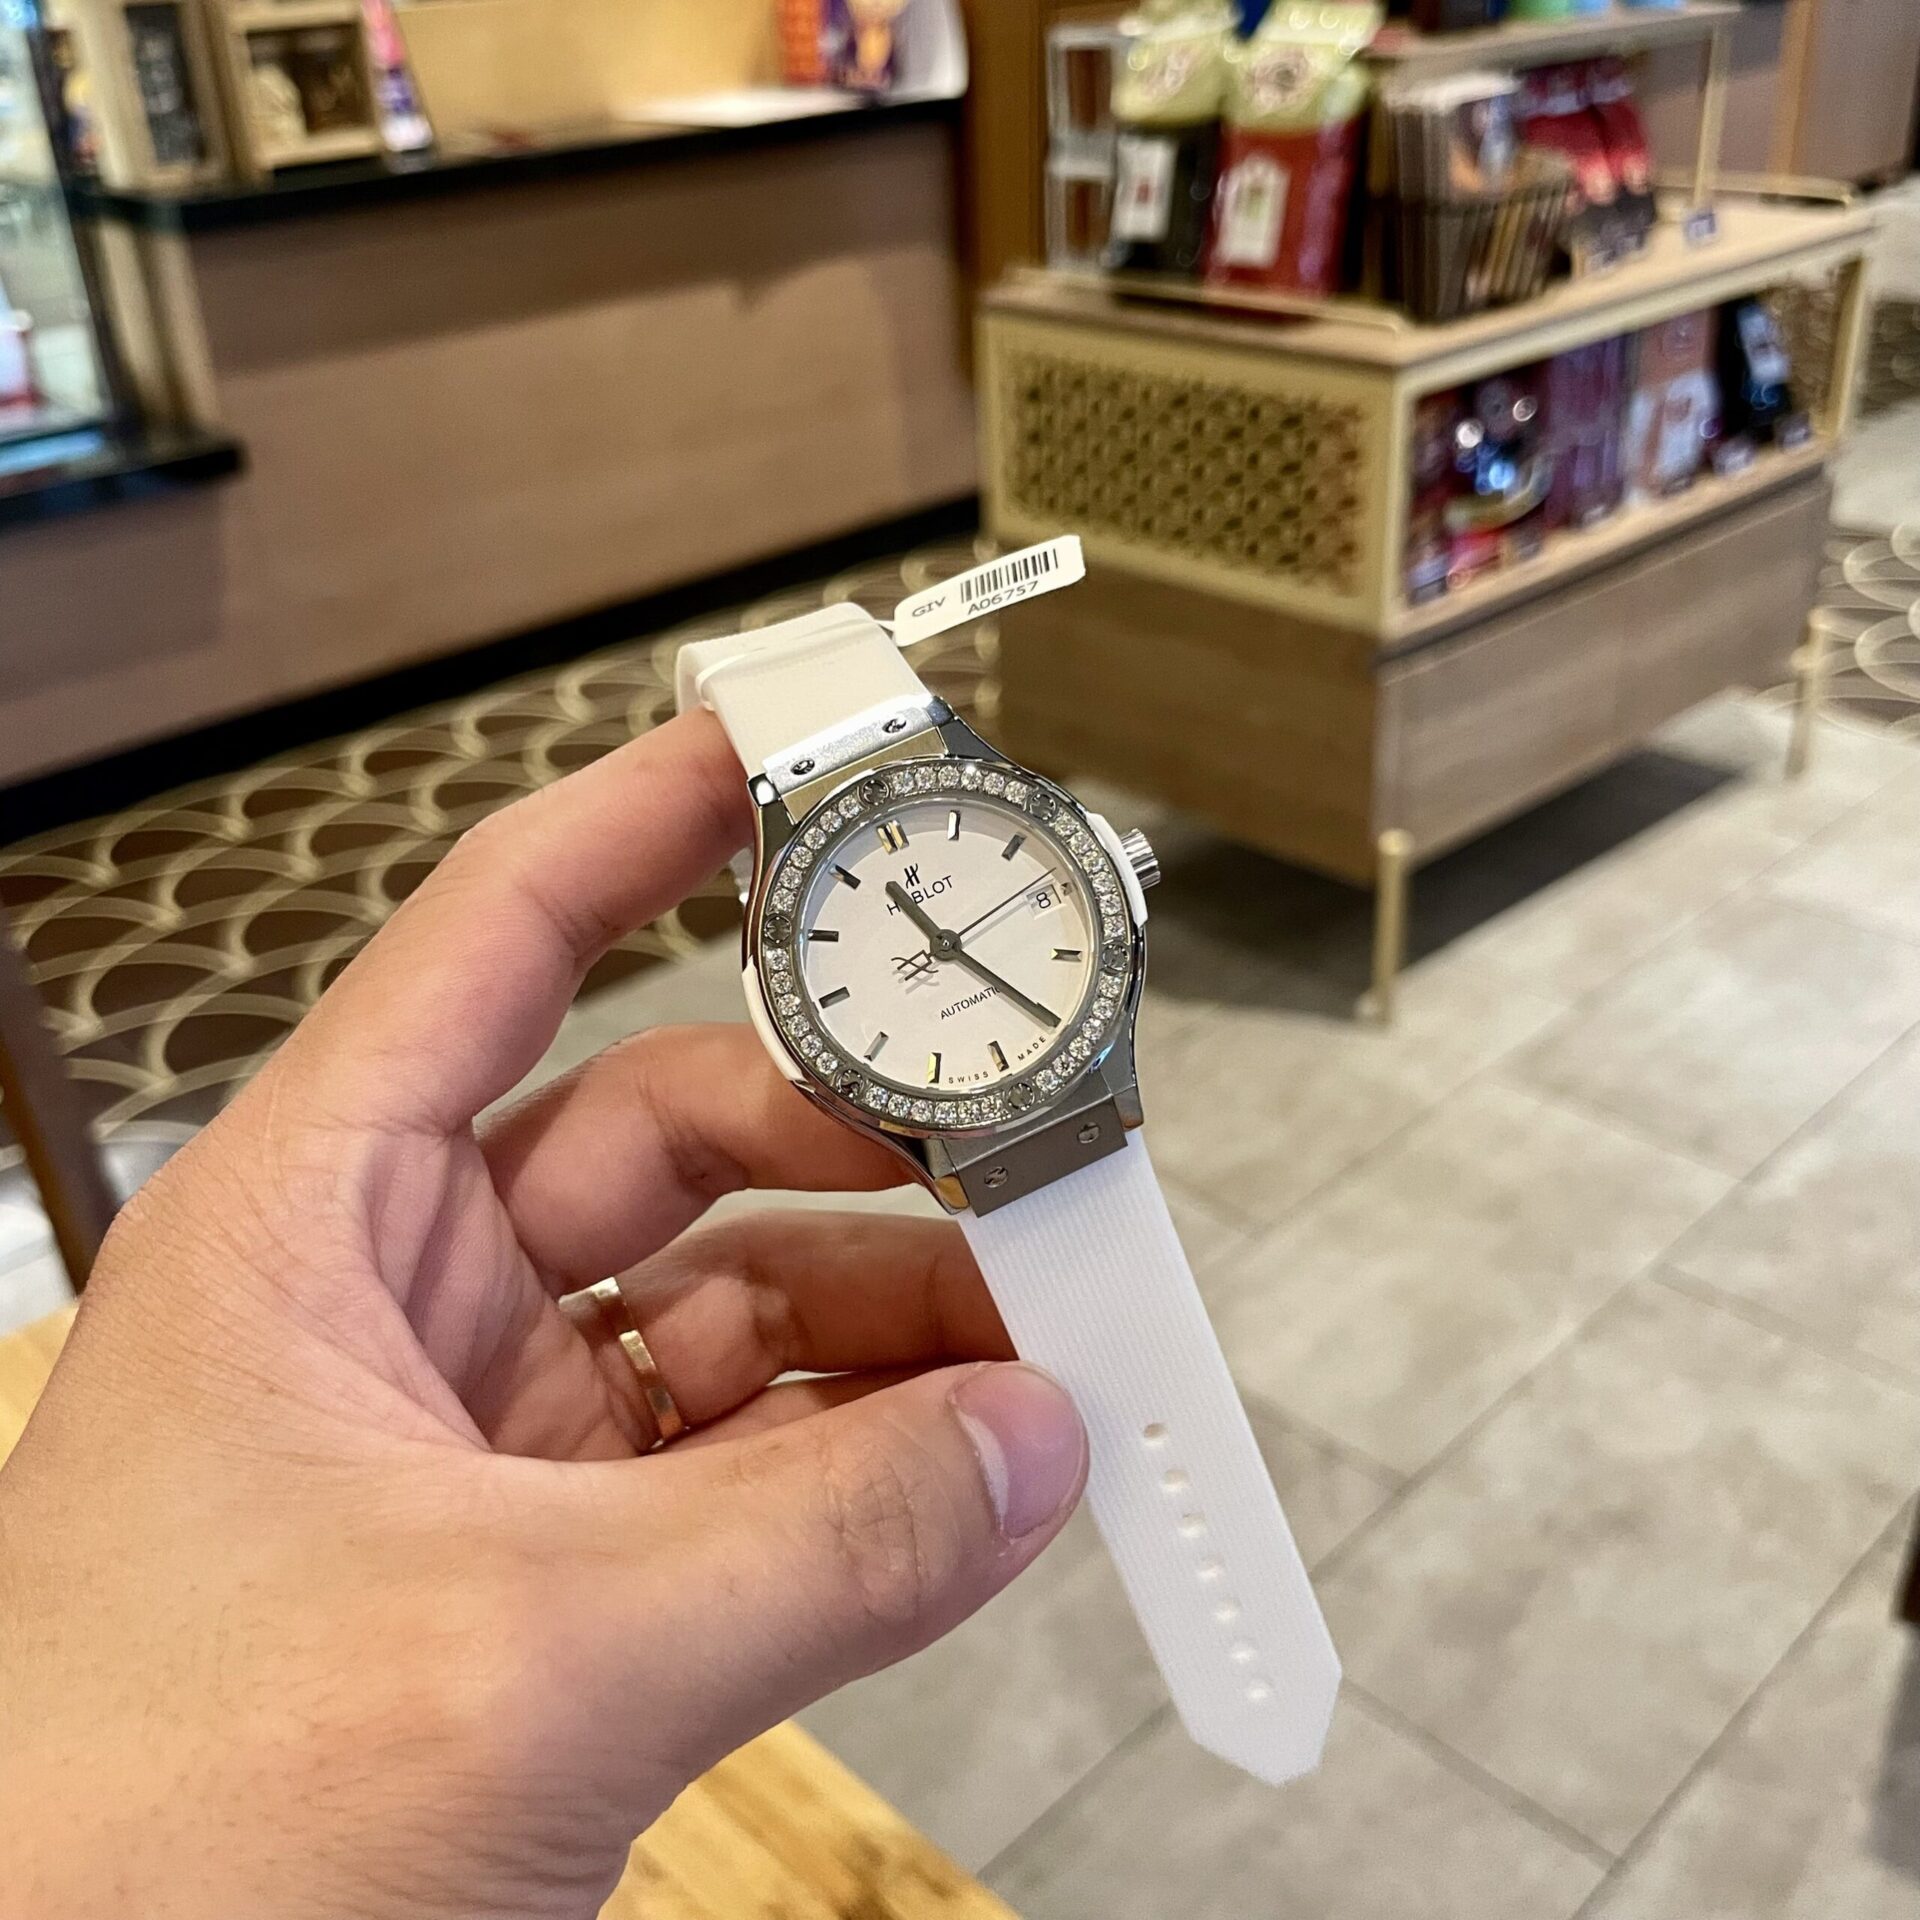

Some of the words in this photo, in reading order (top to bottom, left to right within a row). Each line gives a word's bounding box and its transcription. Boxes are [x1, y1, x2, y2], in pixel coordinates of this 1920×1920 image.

[912, 596, 946, 618] GIV
[967, 580, 1039, 616] A06757
[886, 875, 953, 916] HBLOT
[1036, 891, 1051, 908] 8
[948, 1071, 989, 1084] SWISS
[1017, 1036, 1046, 1061] MADE
